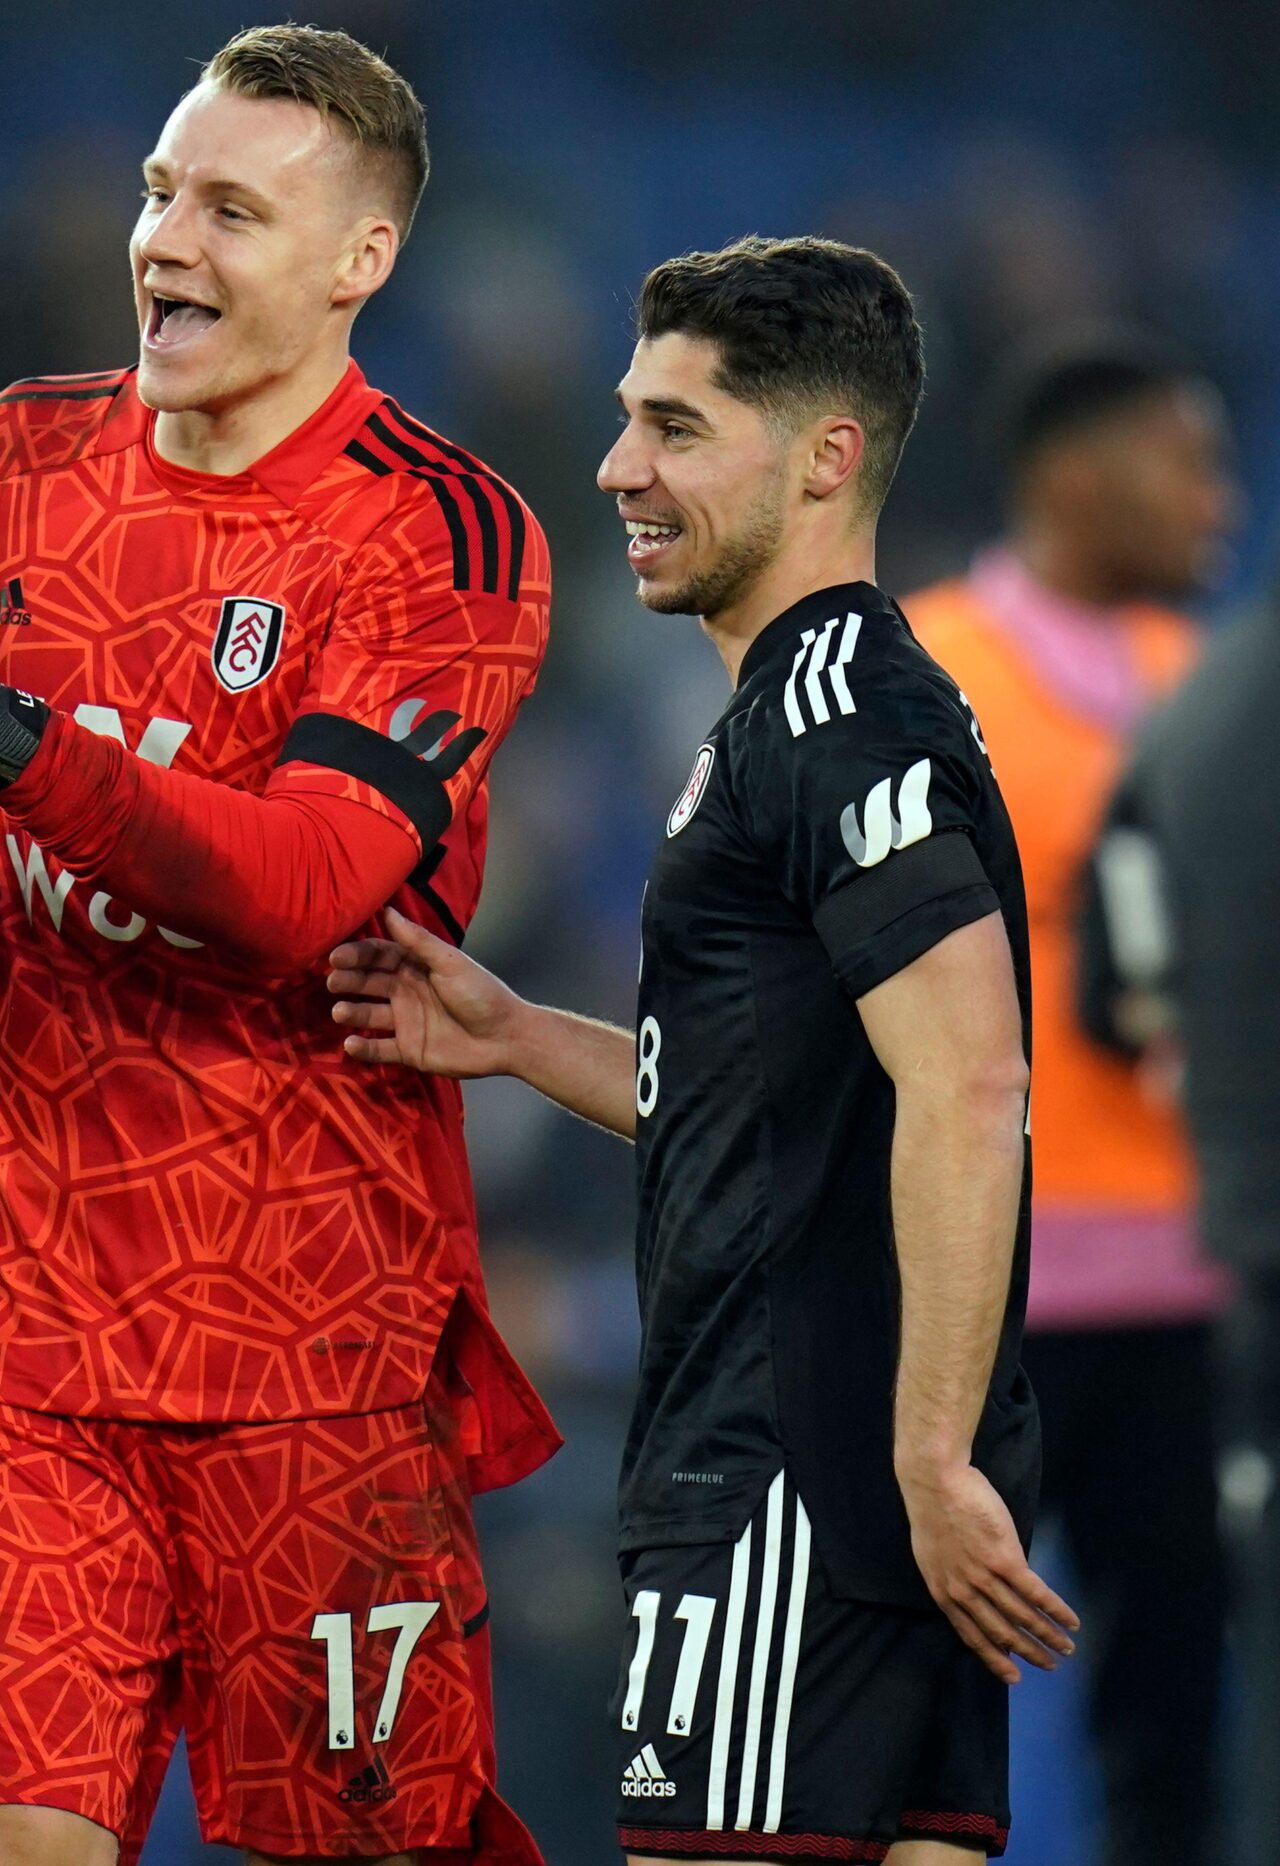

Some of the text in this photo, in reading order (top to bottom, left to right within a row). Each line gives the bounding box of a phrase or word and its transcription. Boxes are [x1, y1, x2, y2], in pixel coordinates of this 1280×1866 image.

[228, 611, 266, 673] FFC
[310, 1601, 441, 1750] 17
[621, 1589, 717, 1737] 11
[620, 1776, 677, 1798] adidas
